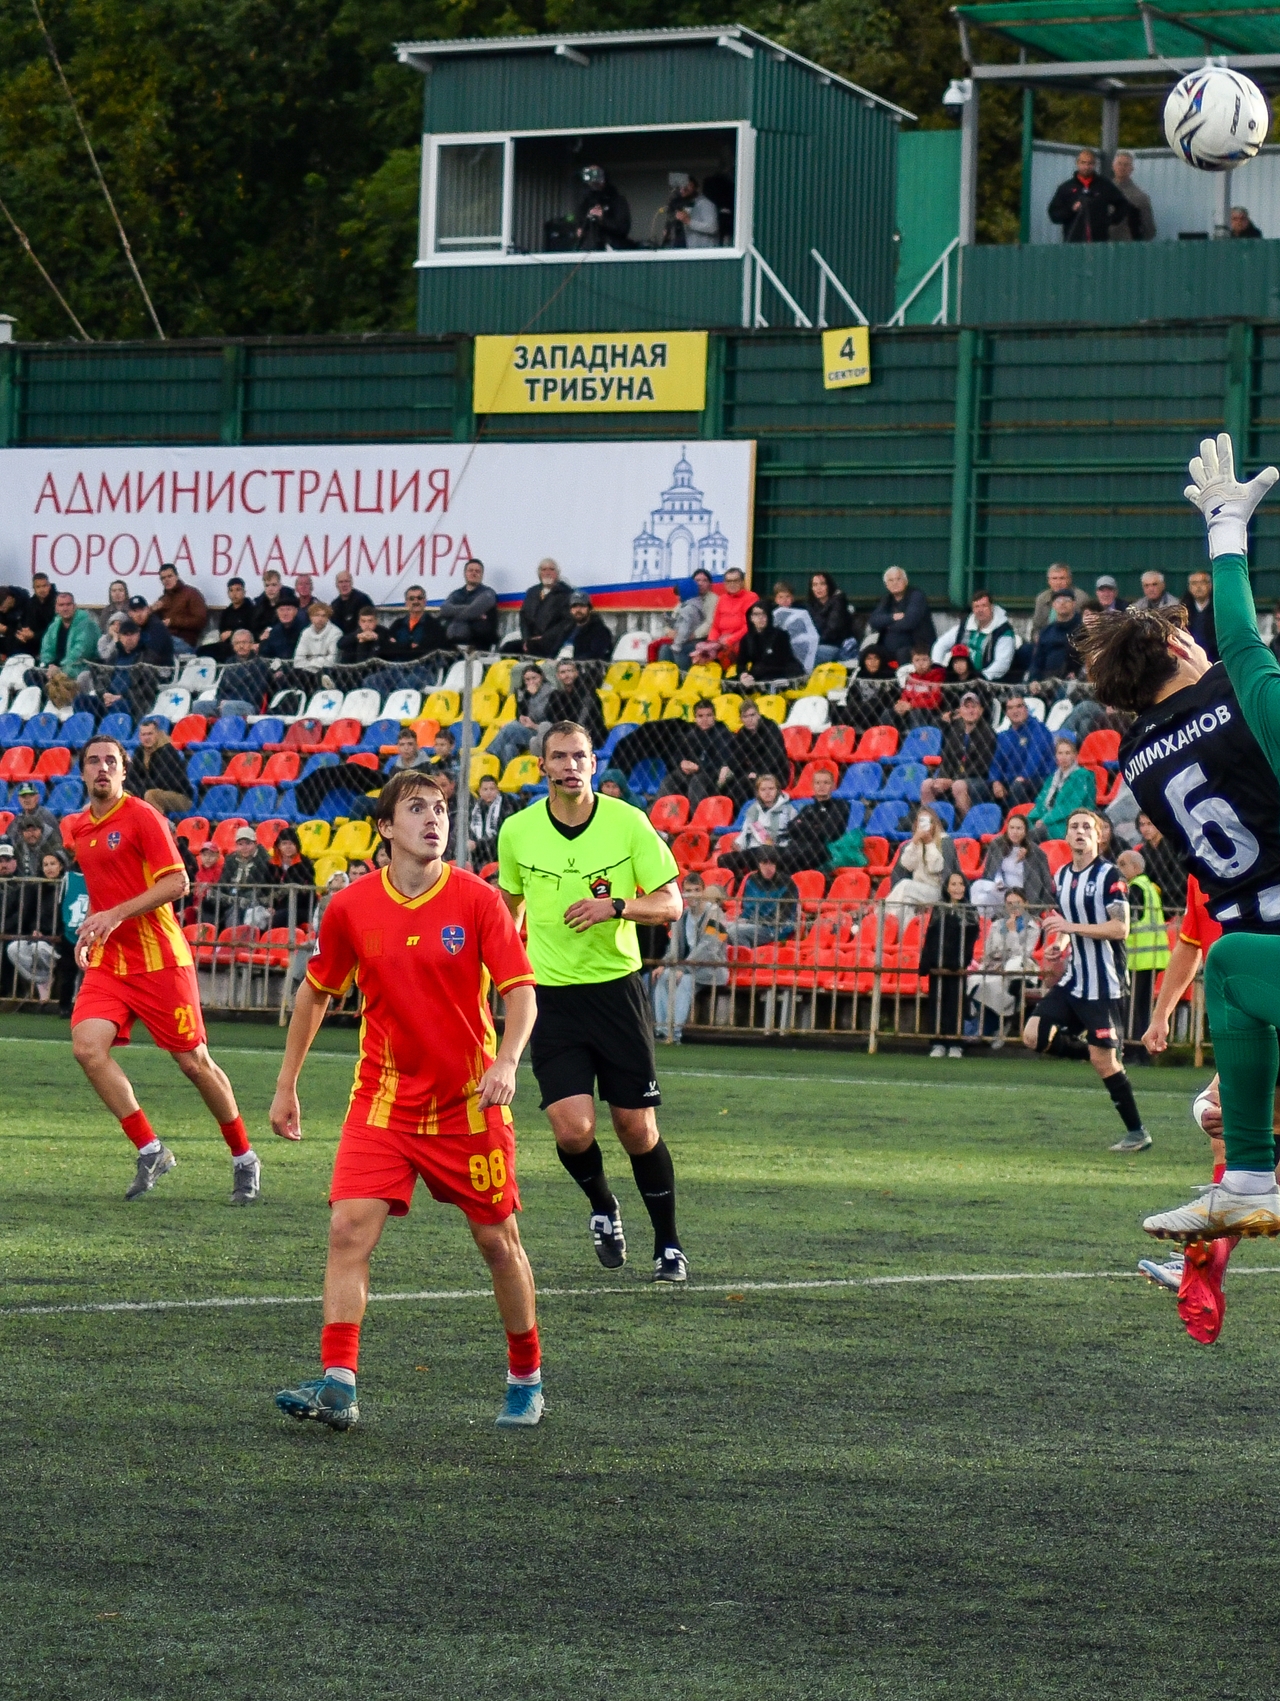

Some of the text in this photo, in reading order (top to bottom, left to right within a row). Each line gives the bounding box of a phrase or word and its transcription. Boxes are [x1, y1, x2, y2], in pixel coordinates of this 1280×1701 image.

[513, 343, 668, 374] ЗАПАДНАЯ
[839, 336, 856, 362] 4
[525, 376, 655, 402] ТРИБУНА
[828, 366, 868, 381] СЕКТОР
[34, 468, 451, 514] АДМИНИСТРАЦИЯ
[31, 533, 474, 577] ГОРОДА ВЛАДИМИРА
[1164, 762, 1260, 879] 6
[174, 1004, 196, 1035] 21
[469, 1149, 507, 1192] 88
